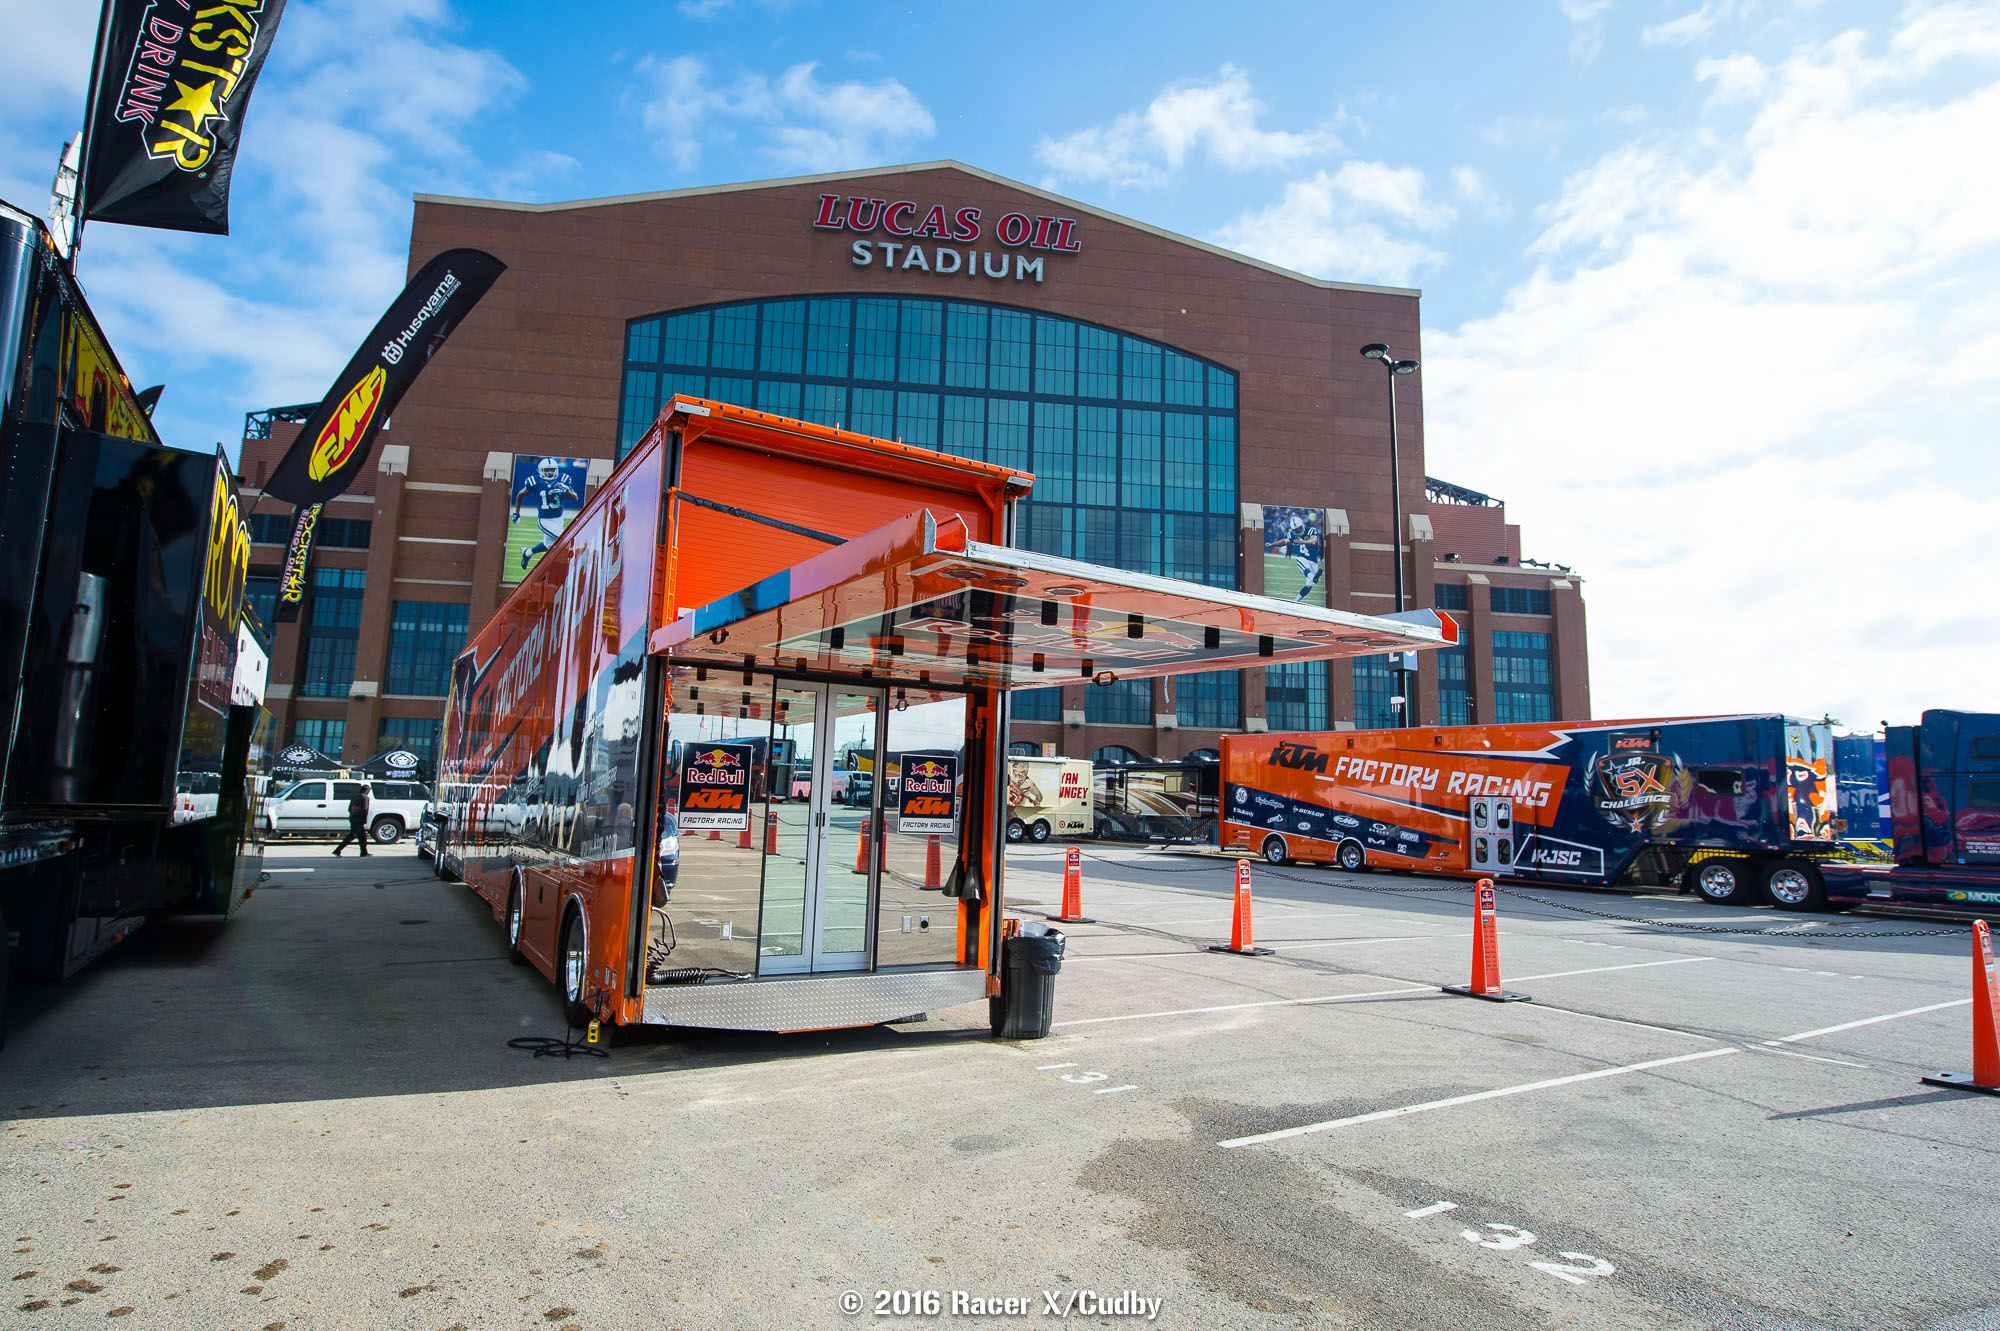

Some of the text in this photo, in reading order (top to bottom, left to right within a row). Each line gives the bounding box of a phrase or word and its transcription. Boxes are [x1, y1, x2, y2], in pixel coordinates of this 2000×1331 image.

[122, 16, 184, 125] DRINK
[813, 193, 1082, 253] LUCAS OIL
[852, 239, 1044, 282] STADIUM
[446, 280, 462, 298] RACING
[396, 273, 455, 348] Husqvarna
[312, 364, 381, 482] FMF
[539, 489, 561, 510] 13
[281, 509, 309, 592] ENERGY DRINK
[1299, 543, 1310, 557] 4
[1616, 738, 1651, 748] KTM
[1268, 743, 1329, 773] KTM
[687, 768, 744, 785] Red Bull
[905, 777, 952, 794] Red Bull
[1335, 756, 1552, 808] FACTORY RACING
[1616, 765, 1666, 796] SX
[685, 789, 744, 809] KTM
[904, 796, 951, 815] KTM
[1600, 795, 1671, 809] CHALLENGE
[682, 816, 743, 825] FACTORY RACING
[1298, 808, 1325, 818] DUNLOP
[1067, 821, 1085, 829] KTM
[1368, 827, 1390, 836] OAKLEY
